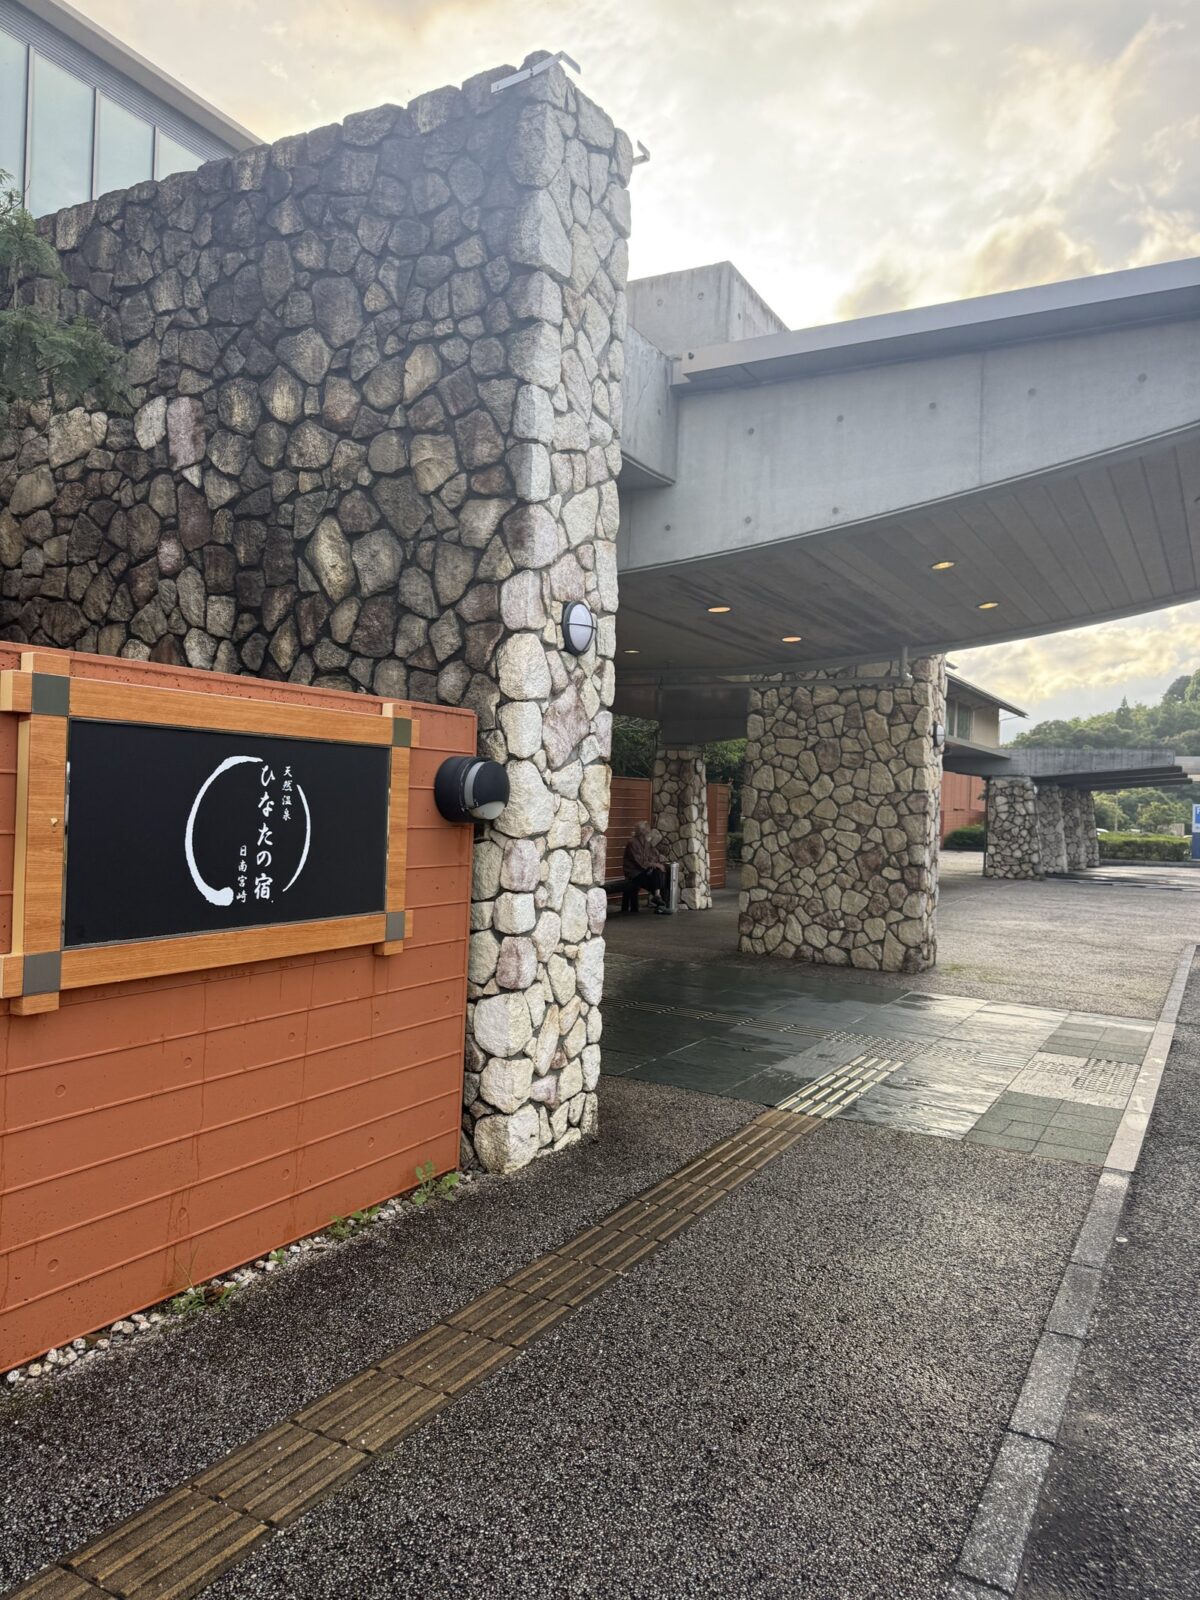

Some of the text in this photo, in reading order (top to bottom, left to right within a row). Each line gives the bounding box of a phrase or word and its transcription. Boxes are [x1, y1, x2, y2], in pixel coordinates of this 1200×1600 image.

[281, 765, 293, 821] 天然温泉
[254, 764, 276, 900] ひなたの宿
[236, 844, 248, 903] 日南宮崎
